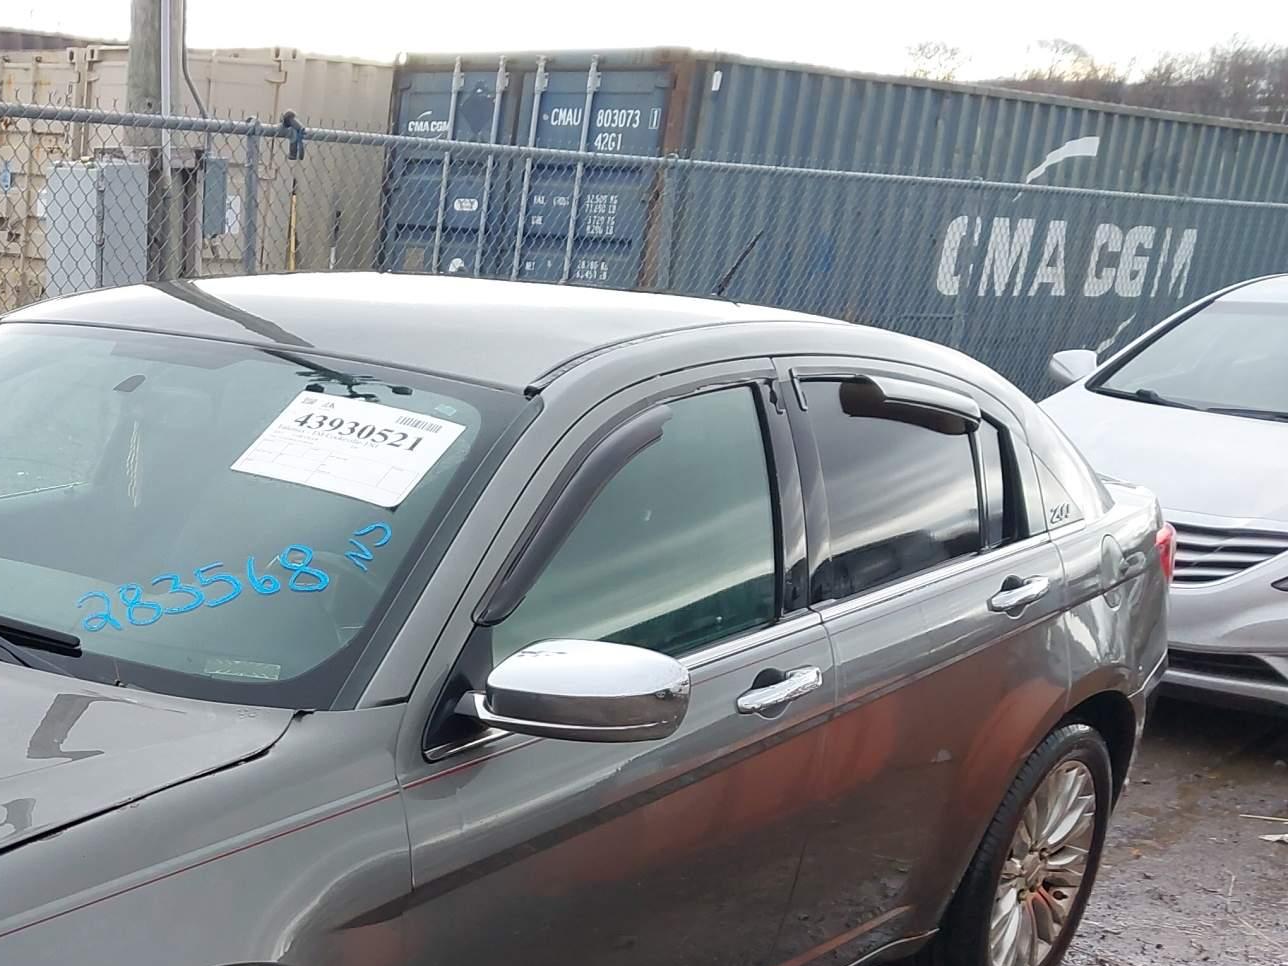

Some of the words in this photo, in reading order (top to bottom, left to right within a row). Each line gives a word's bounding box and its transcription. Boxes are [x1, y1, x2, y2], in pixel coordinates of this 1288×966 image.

[408, 120, 430, 133] CMA
[550, 108, 582, 127] CMAU
[596, 109, 641, 128] 803073
[593, 132, 623, 152] 42G1
[936, 215, 1068, 298] CMA
[294, 412, 424, 452] 43930521
[77, 543, 330, 632] 283568
